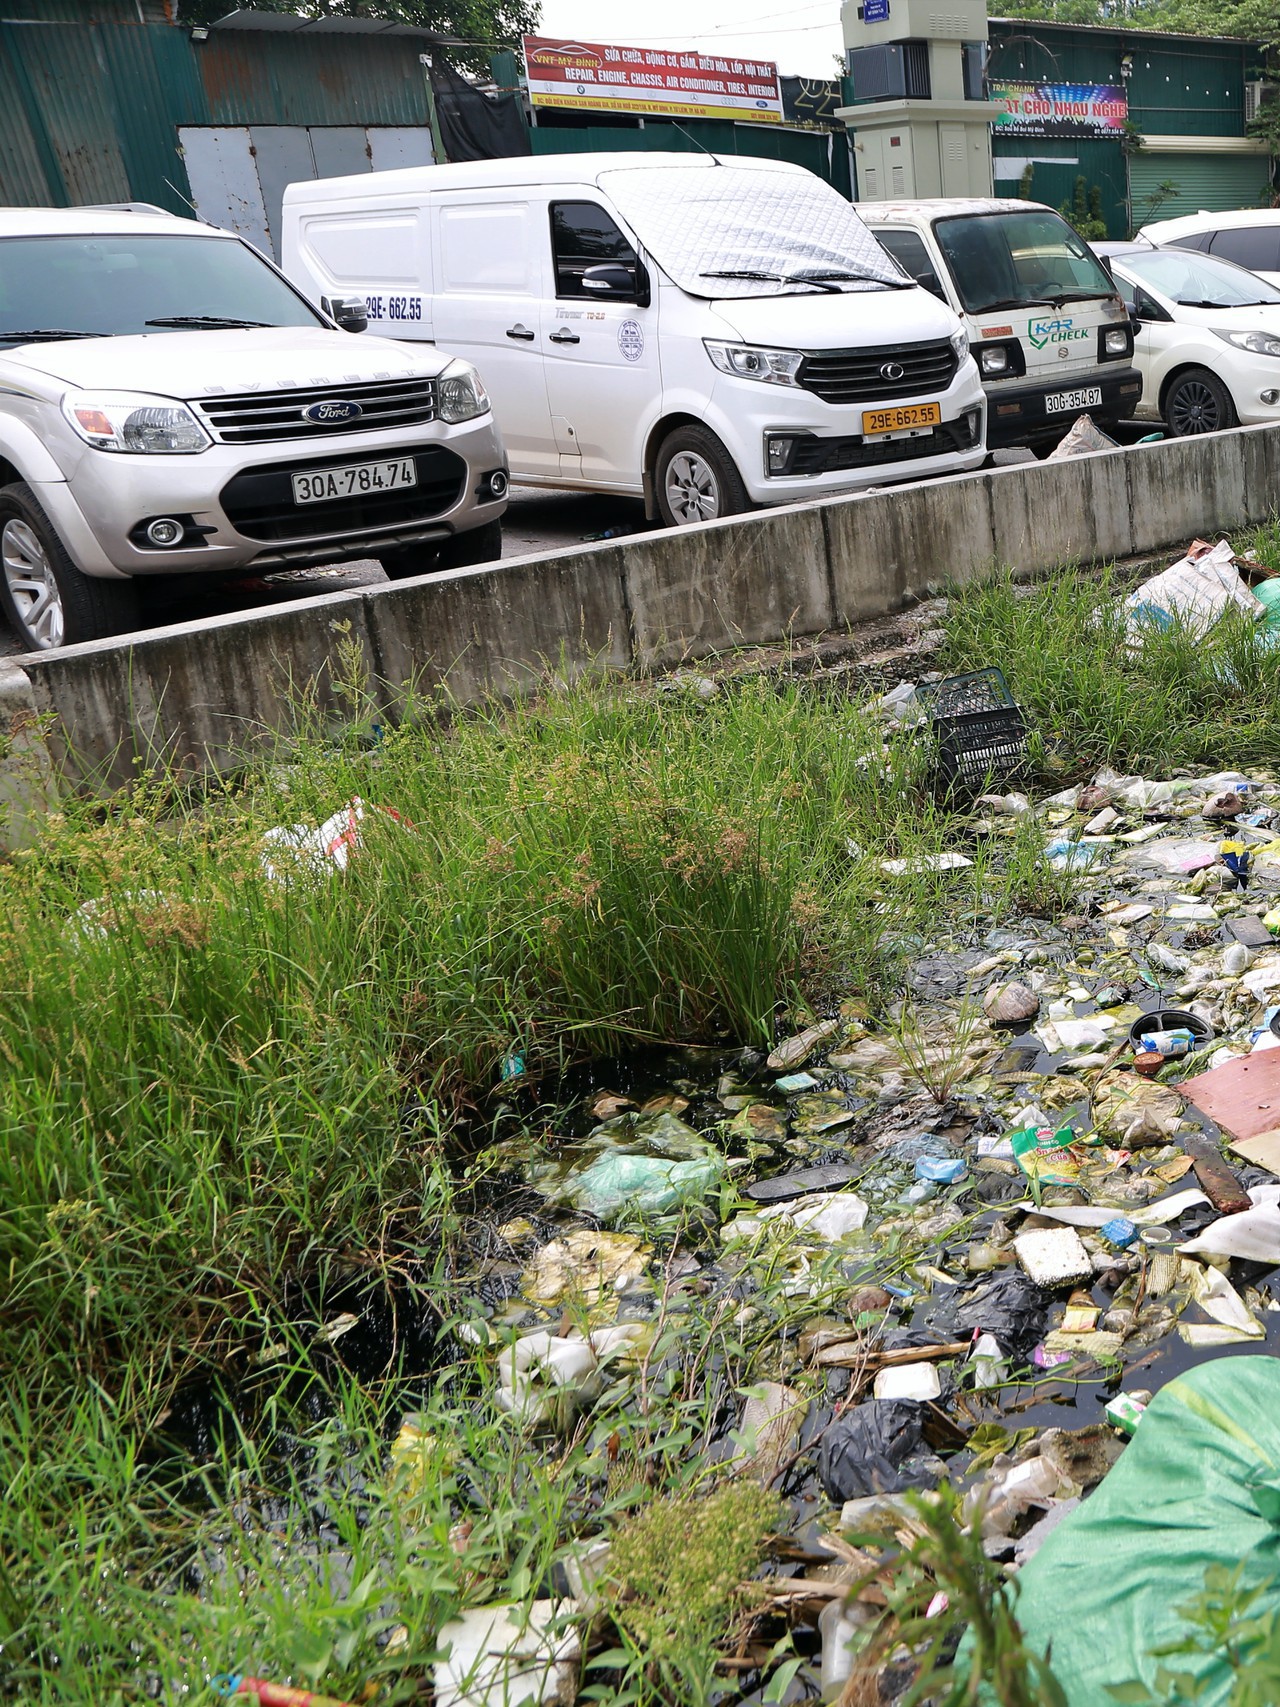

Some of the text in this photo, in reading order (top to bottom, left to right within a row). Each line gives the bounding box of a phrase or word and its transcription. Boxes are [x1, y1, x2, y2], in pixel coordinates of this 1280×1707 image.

[536, 55, 555, 65] VNT
[604, 45, 621, 62] SỬA
[622, 49, 645, 65] CHỮA,
[645, 51, 667, 68] ĐỘNG
[667, 54, 680, 69] CƠ,
[715, 58, 731, 74] HÒA,
[745, 61, 757, 79] NỘI
[564, 67, 777, 98] REPAIR, ENGINE, CHASSIS, AIR CONDITIONER, TIRES, INTERIOR
[1009, 85, 1035, 93] CHANH
[1024, 100, 1050, 115] CHO
[1054, 101, 1089, 116] NHAU
[1092, 102, 1127, 118] NGHE
[389, 296, 422, 320] 662.55
[1035, 319, 1073, 334] KAR
[1051, 329, 1089, 343] CHECK
[204, 369, 416, 394] EVEREST
[317, 403, 351, 420] Ford
[1046, 388, 1101, 412] 30G-354.87
[869, 407, 935, 430] 29E-662.55
[297, 461, 413, 501] 30A-784.74
